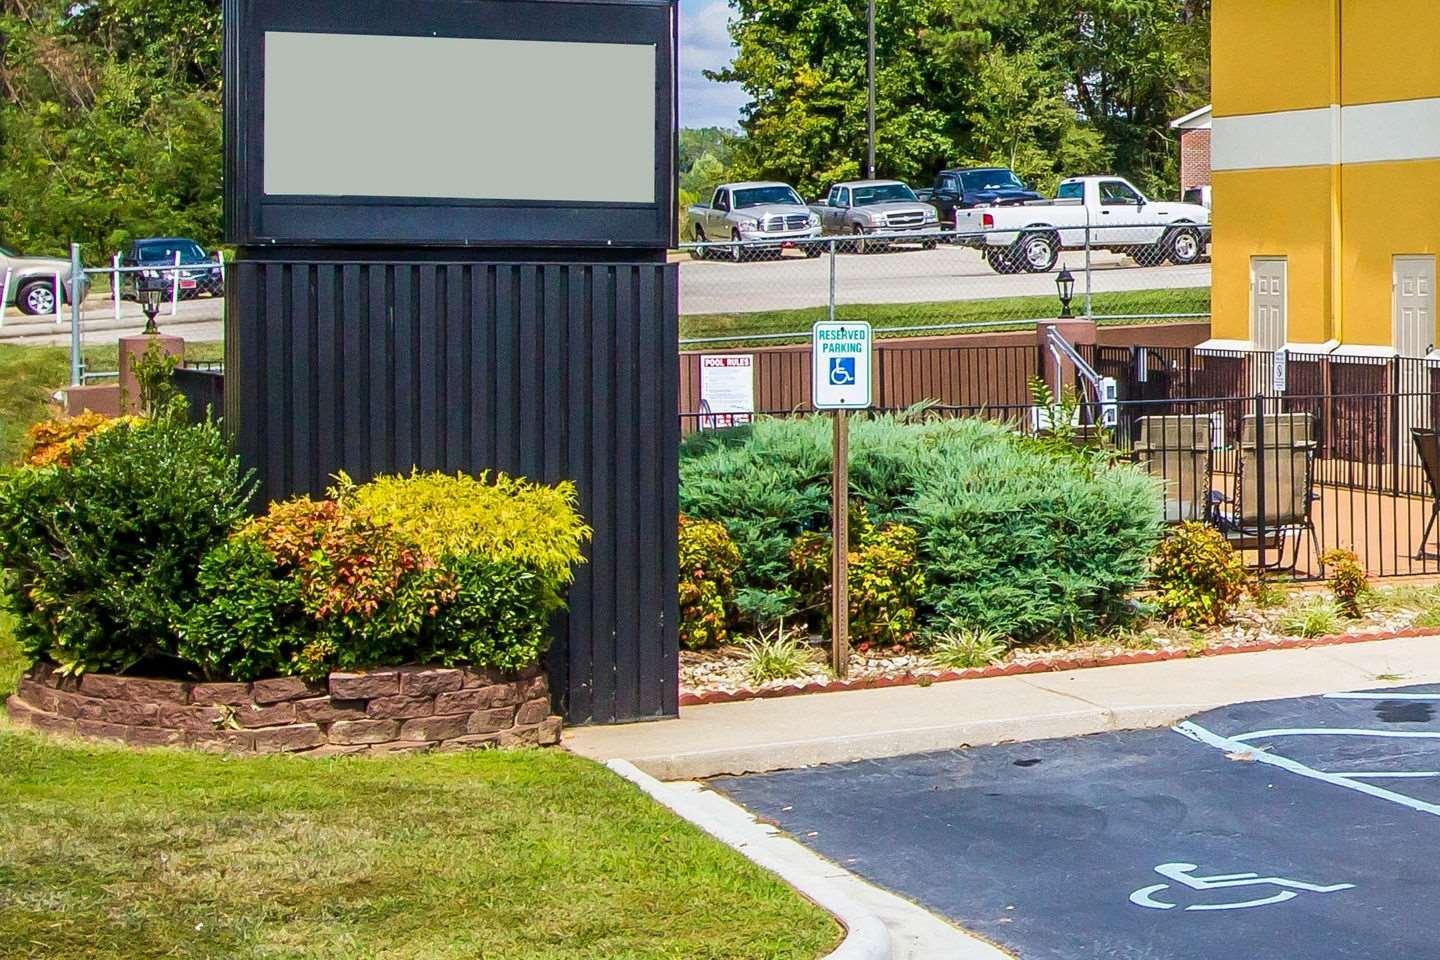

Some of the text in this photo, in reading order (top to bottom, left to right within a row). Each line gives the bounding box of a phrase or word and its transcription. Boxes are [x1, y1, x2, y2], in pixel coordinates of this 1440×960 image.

[819, 329, 865, 340] RESERVED
[822, 342, 862, 353] PARKING
[704, 357, 750, 367] POOL RULES
